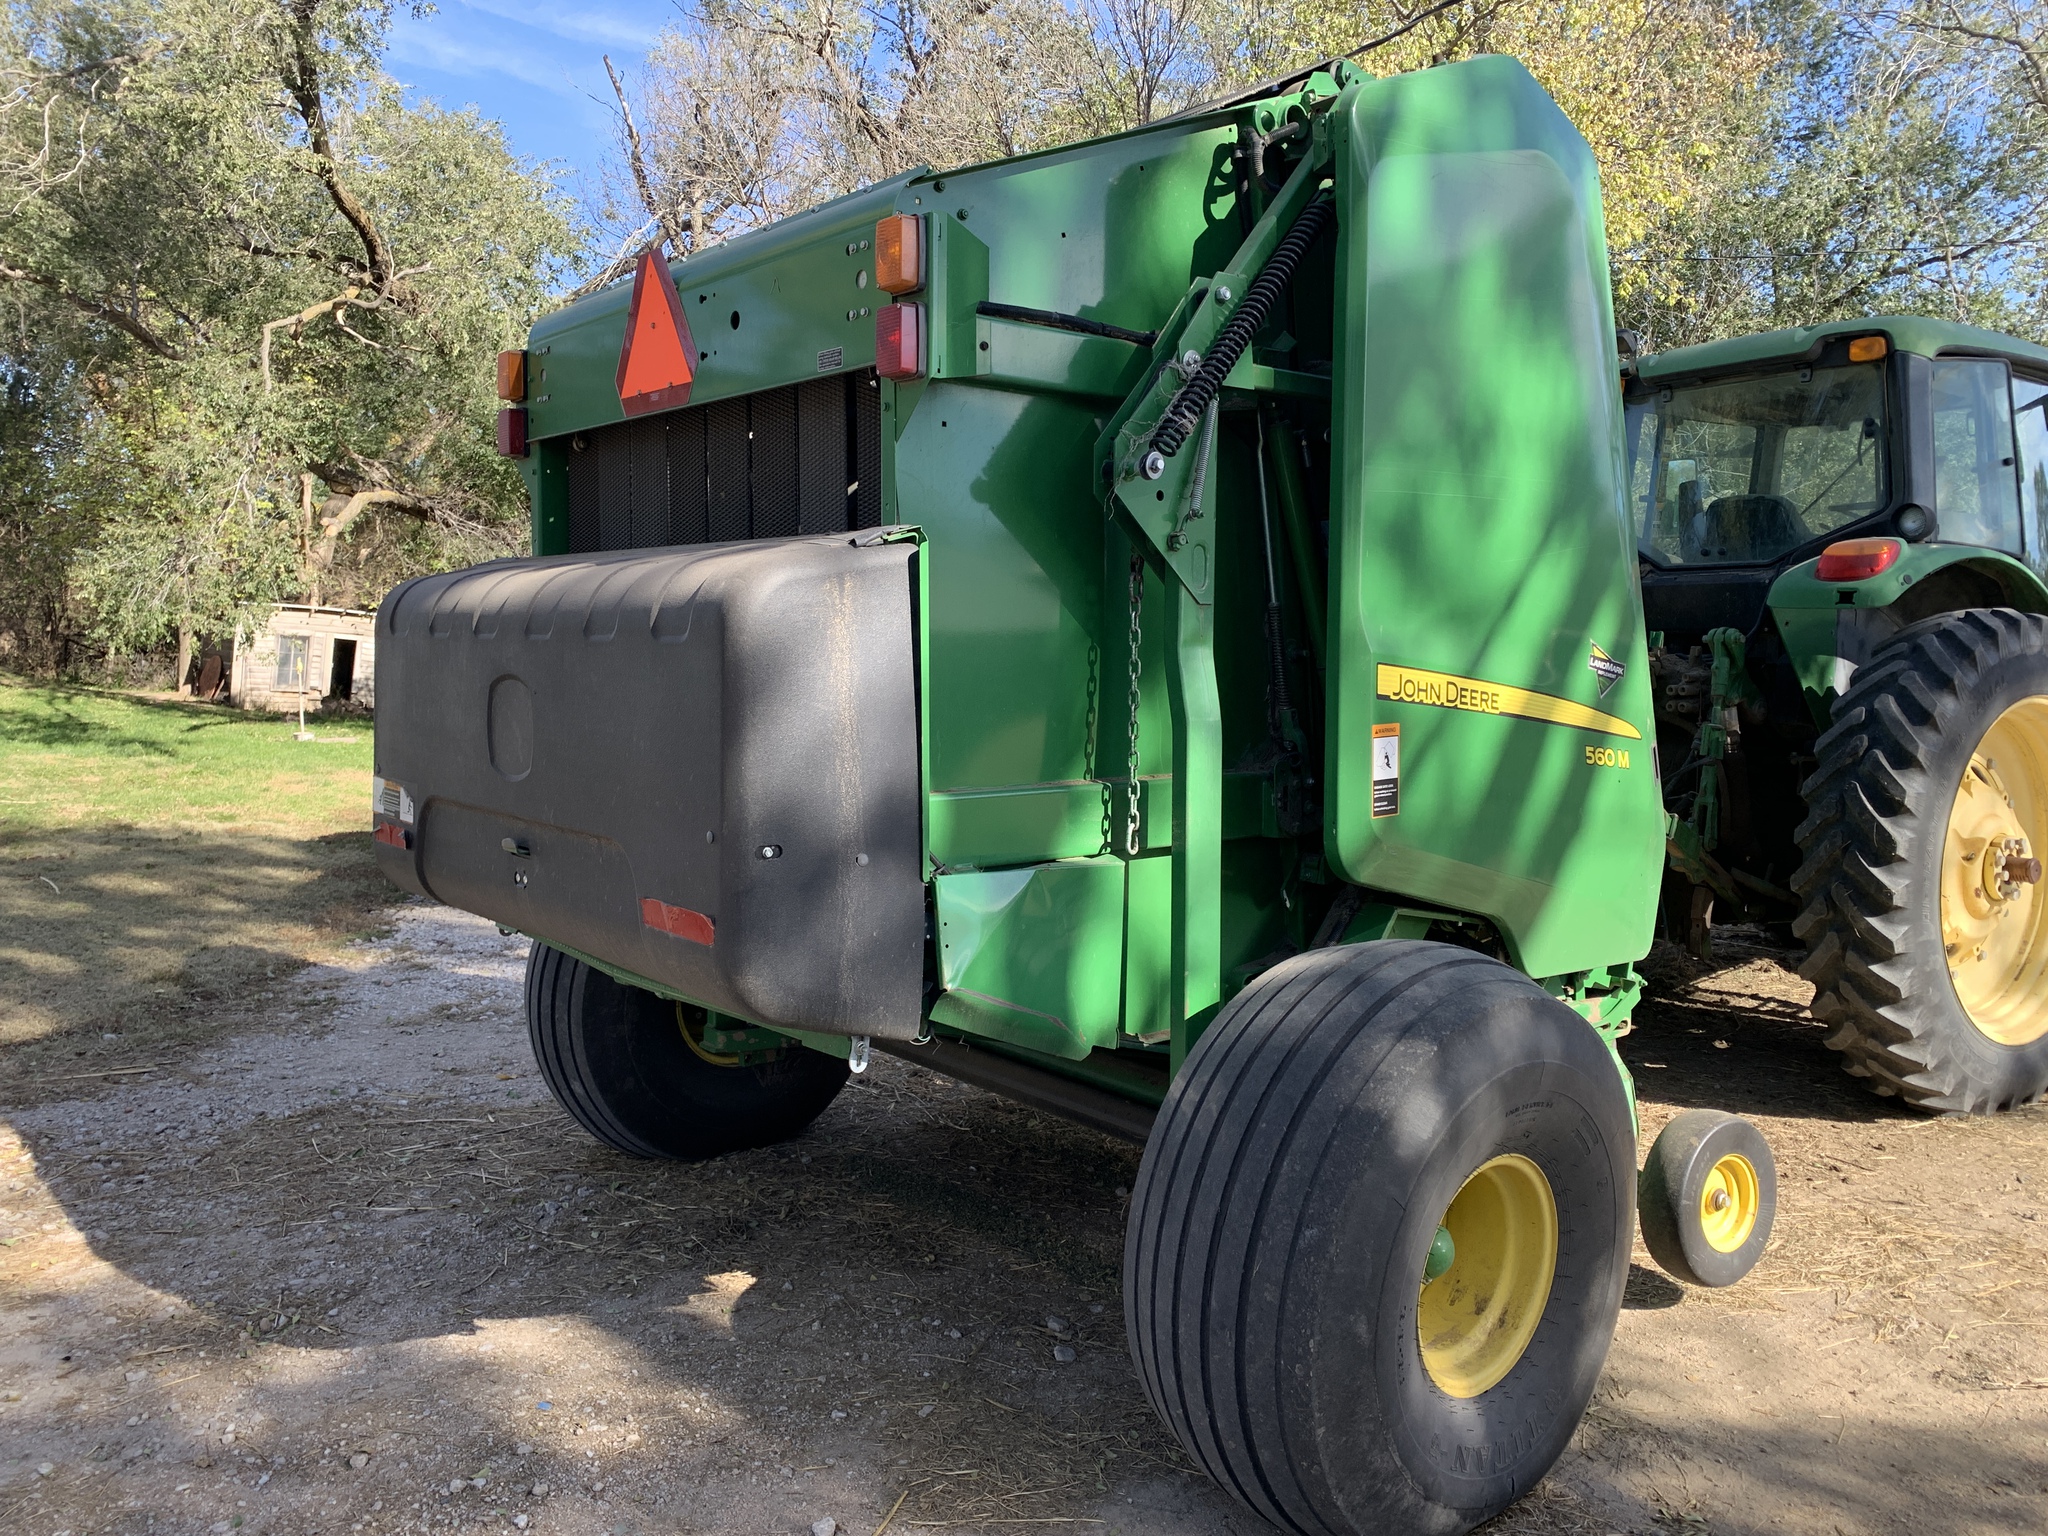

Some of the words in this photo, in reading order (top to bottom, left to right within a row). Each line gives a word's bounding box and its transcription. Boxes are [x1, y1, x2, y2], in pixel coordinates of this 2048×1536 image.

[1392, 673, 1441, 702] JOHN
[1446, 681, 1500, 711] DEERE
[1585, 745, 1615, 767] 560
[1450, 1411, 1545, 1474] TITAN
